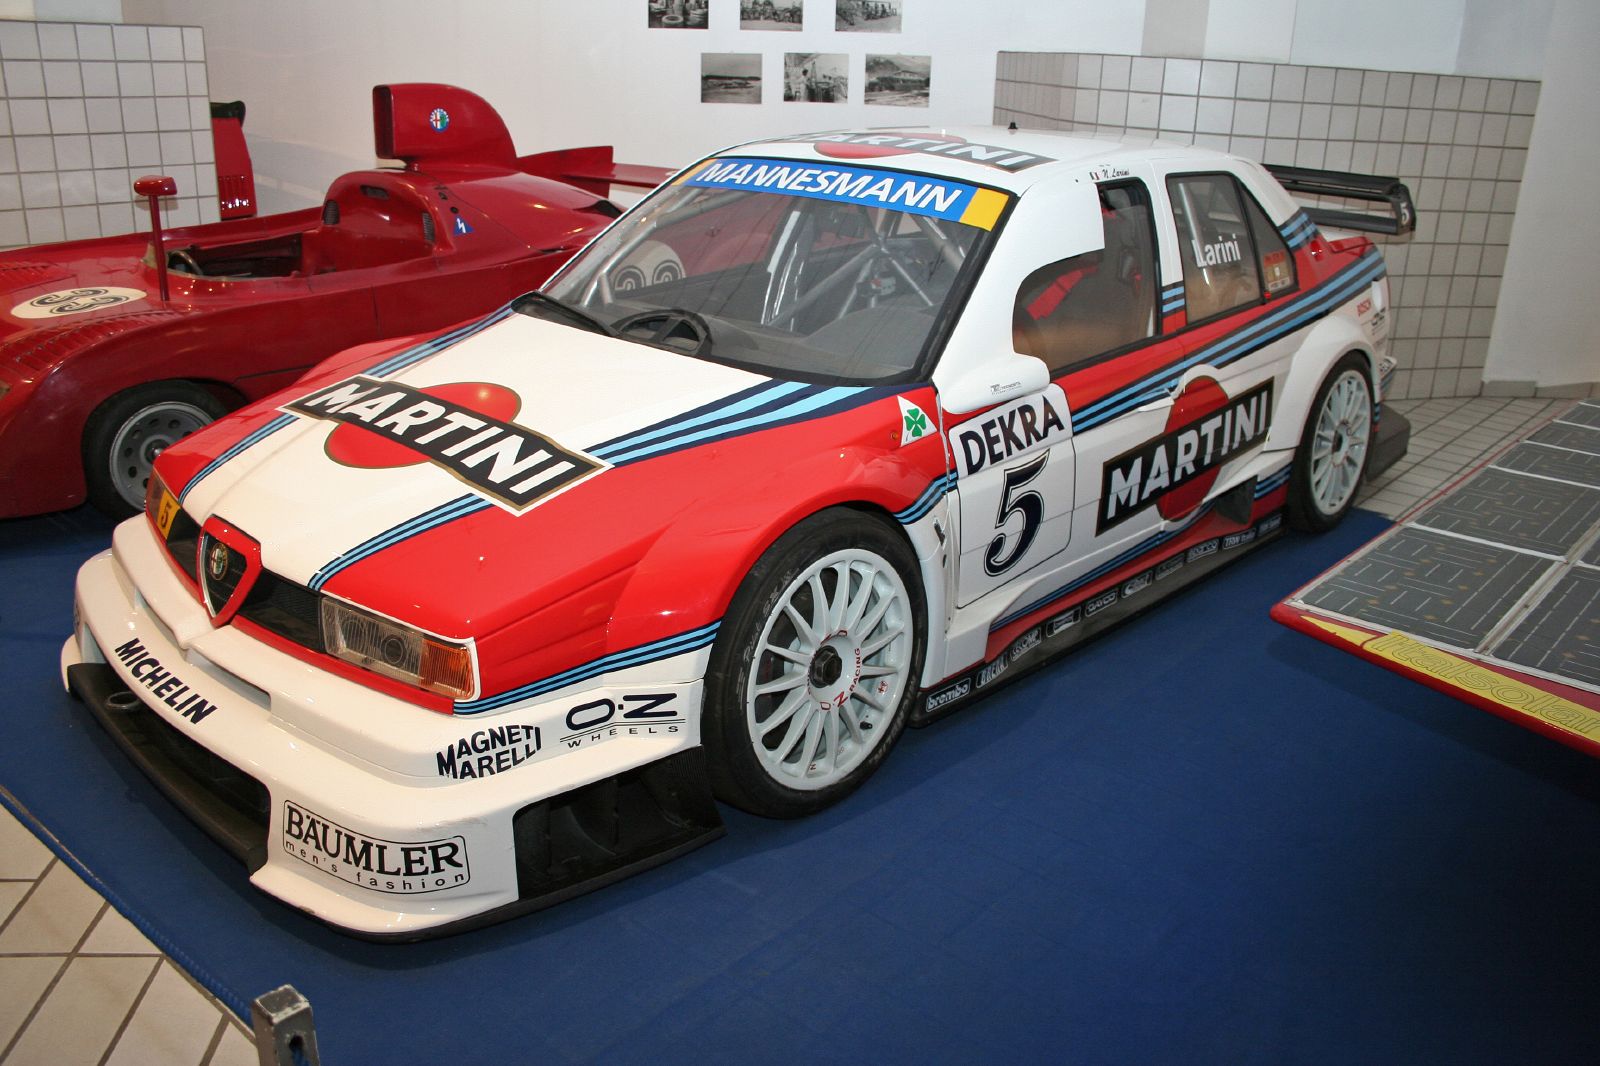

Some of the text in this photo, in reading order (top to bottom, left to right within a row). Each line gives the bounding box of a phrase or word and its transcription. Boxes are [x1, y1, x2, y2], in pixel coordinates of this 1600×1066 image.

[699, 162, 962, 212] MANNESMANN
[1400, 203, 1410, 225] 5
[1191, 233, 1241, 268] Larini
[303, 383, 576, 494] MARTINI
[959, 395, 1064, 476] DEKRA
[1106, 391, 1268, 520] MARTINI
[160, 501, 172, 528] 5
[983, 448, 1050, 577] 5
[114, 637, 218, 725] MICHELIN
[849, 647, 861, 692] RACING
[927, 681, 969, 710] brembo
[567, 725, 679, 749] WHEELS
[285, 804, 463, 877] BÄUMLER
[285, 840, 464, 890] men's fashion
